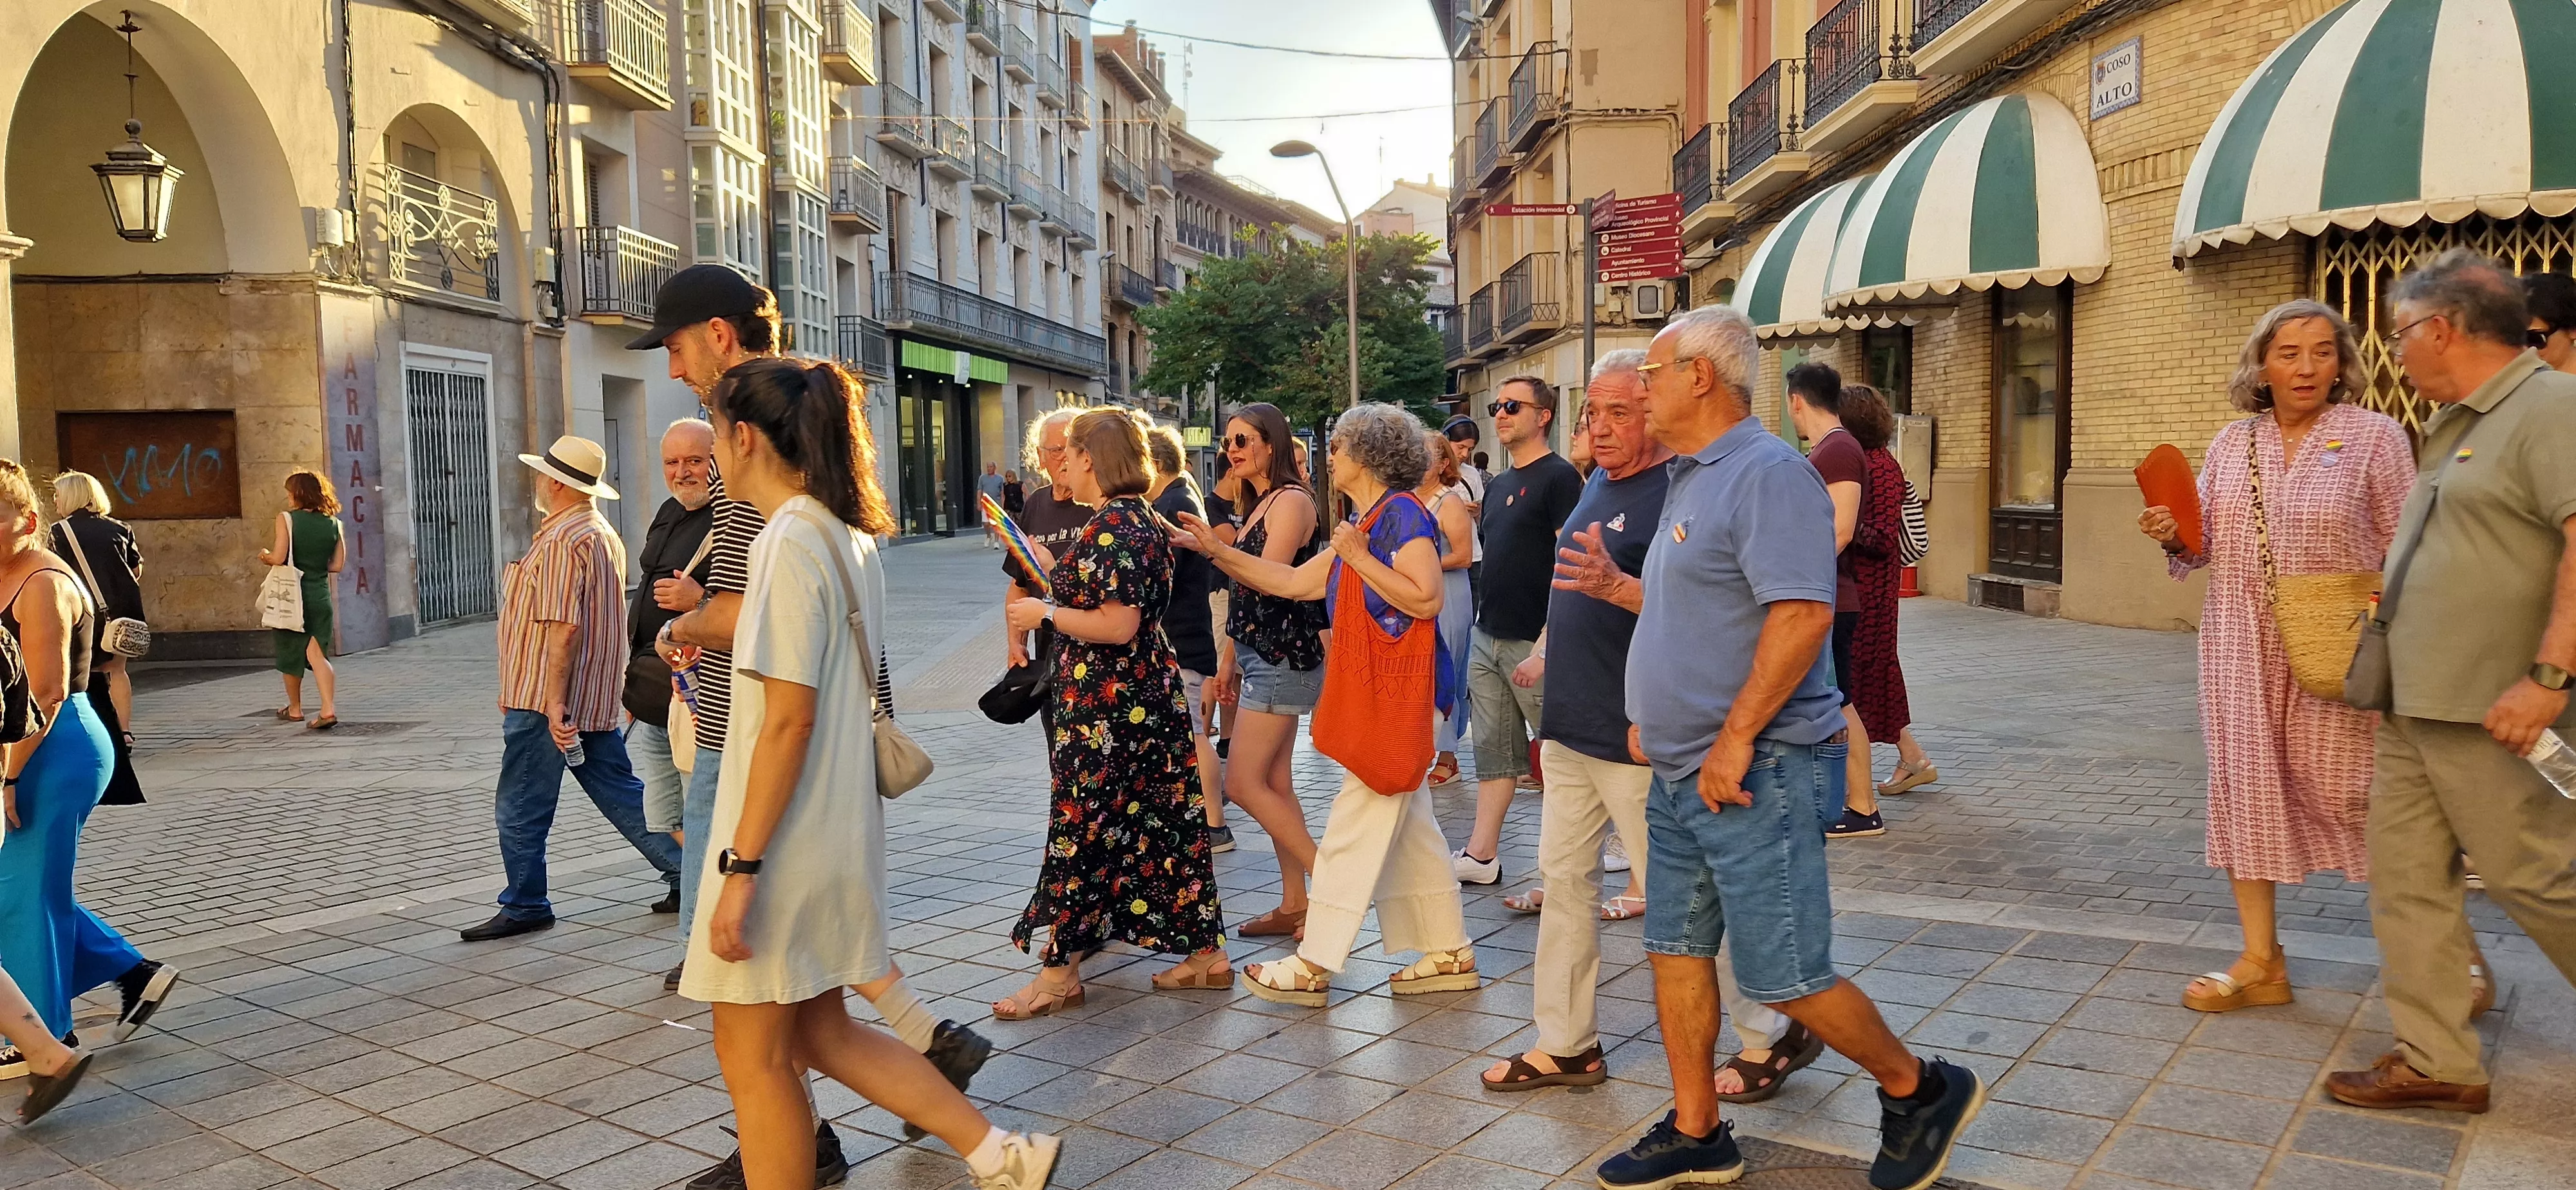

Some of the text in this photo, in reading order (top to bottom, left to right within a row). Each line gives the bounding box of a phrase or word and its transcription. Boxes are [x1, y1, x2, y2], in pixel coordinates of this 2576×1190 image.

[2107, 53, 2131, 73] COSO
[2096, 82, 2132, 108] ALTO
[1611, 215, 1669, 228] Arqueológico Provincial
[1611, 258, 1645, 267] Ayuntamiento
[343, 316, 370, 595] FARMACIA
[1046, 533, 1058, 547] por
[1058, 527, 1068, 540] la
